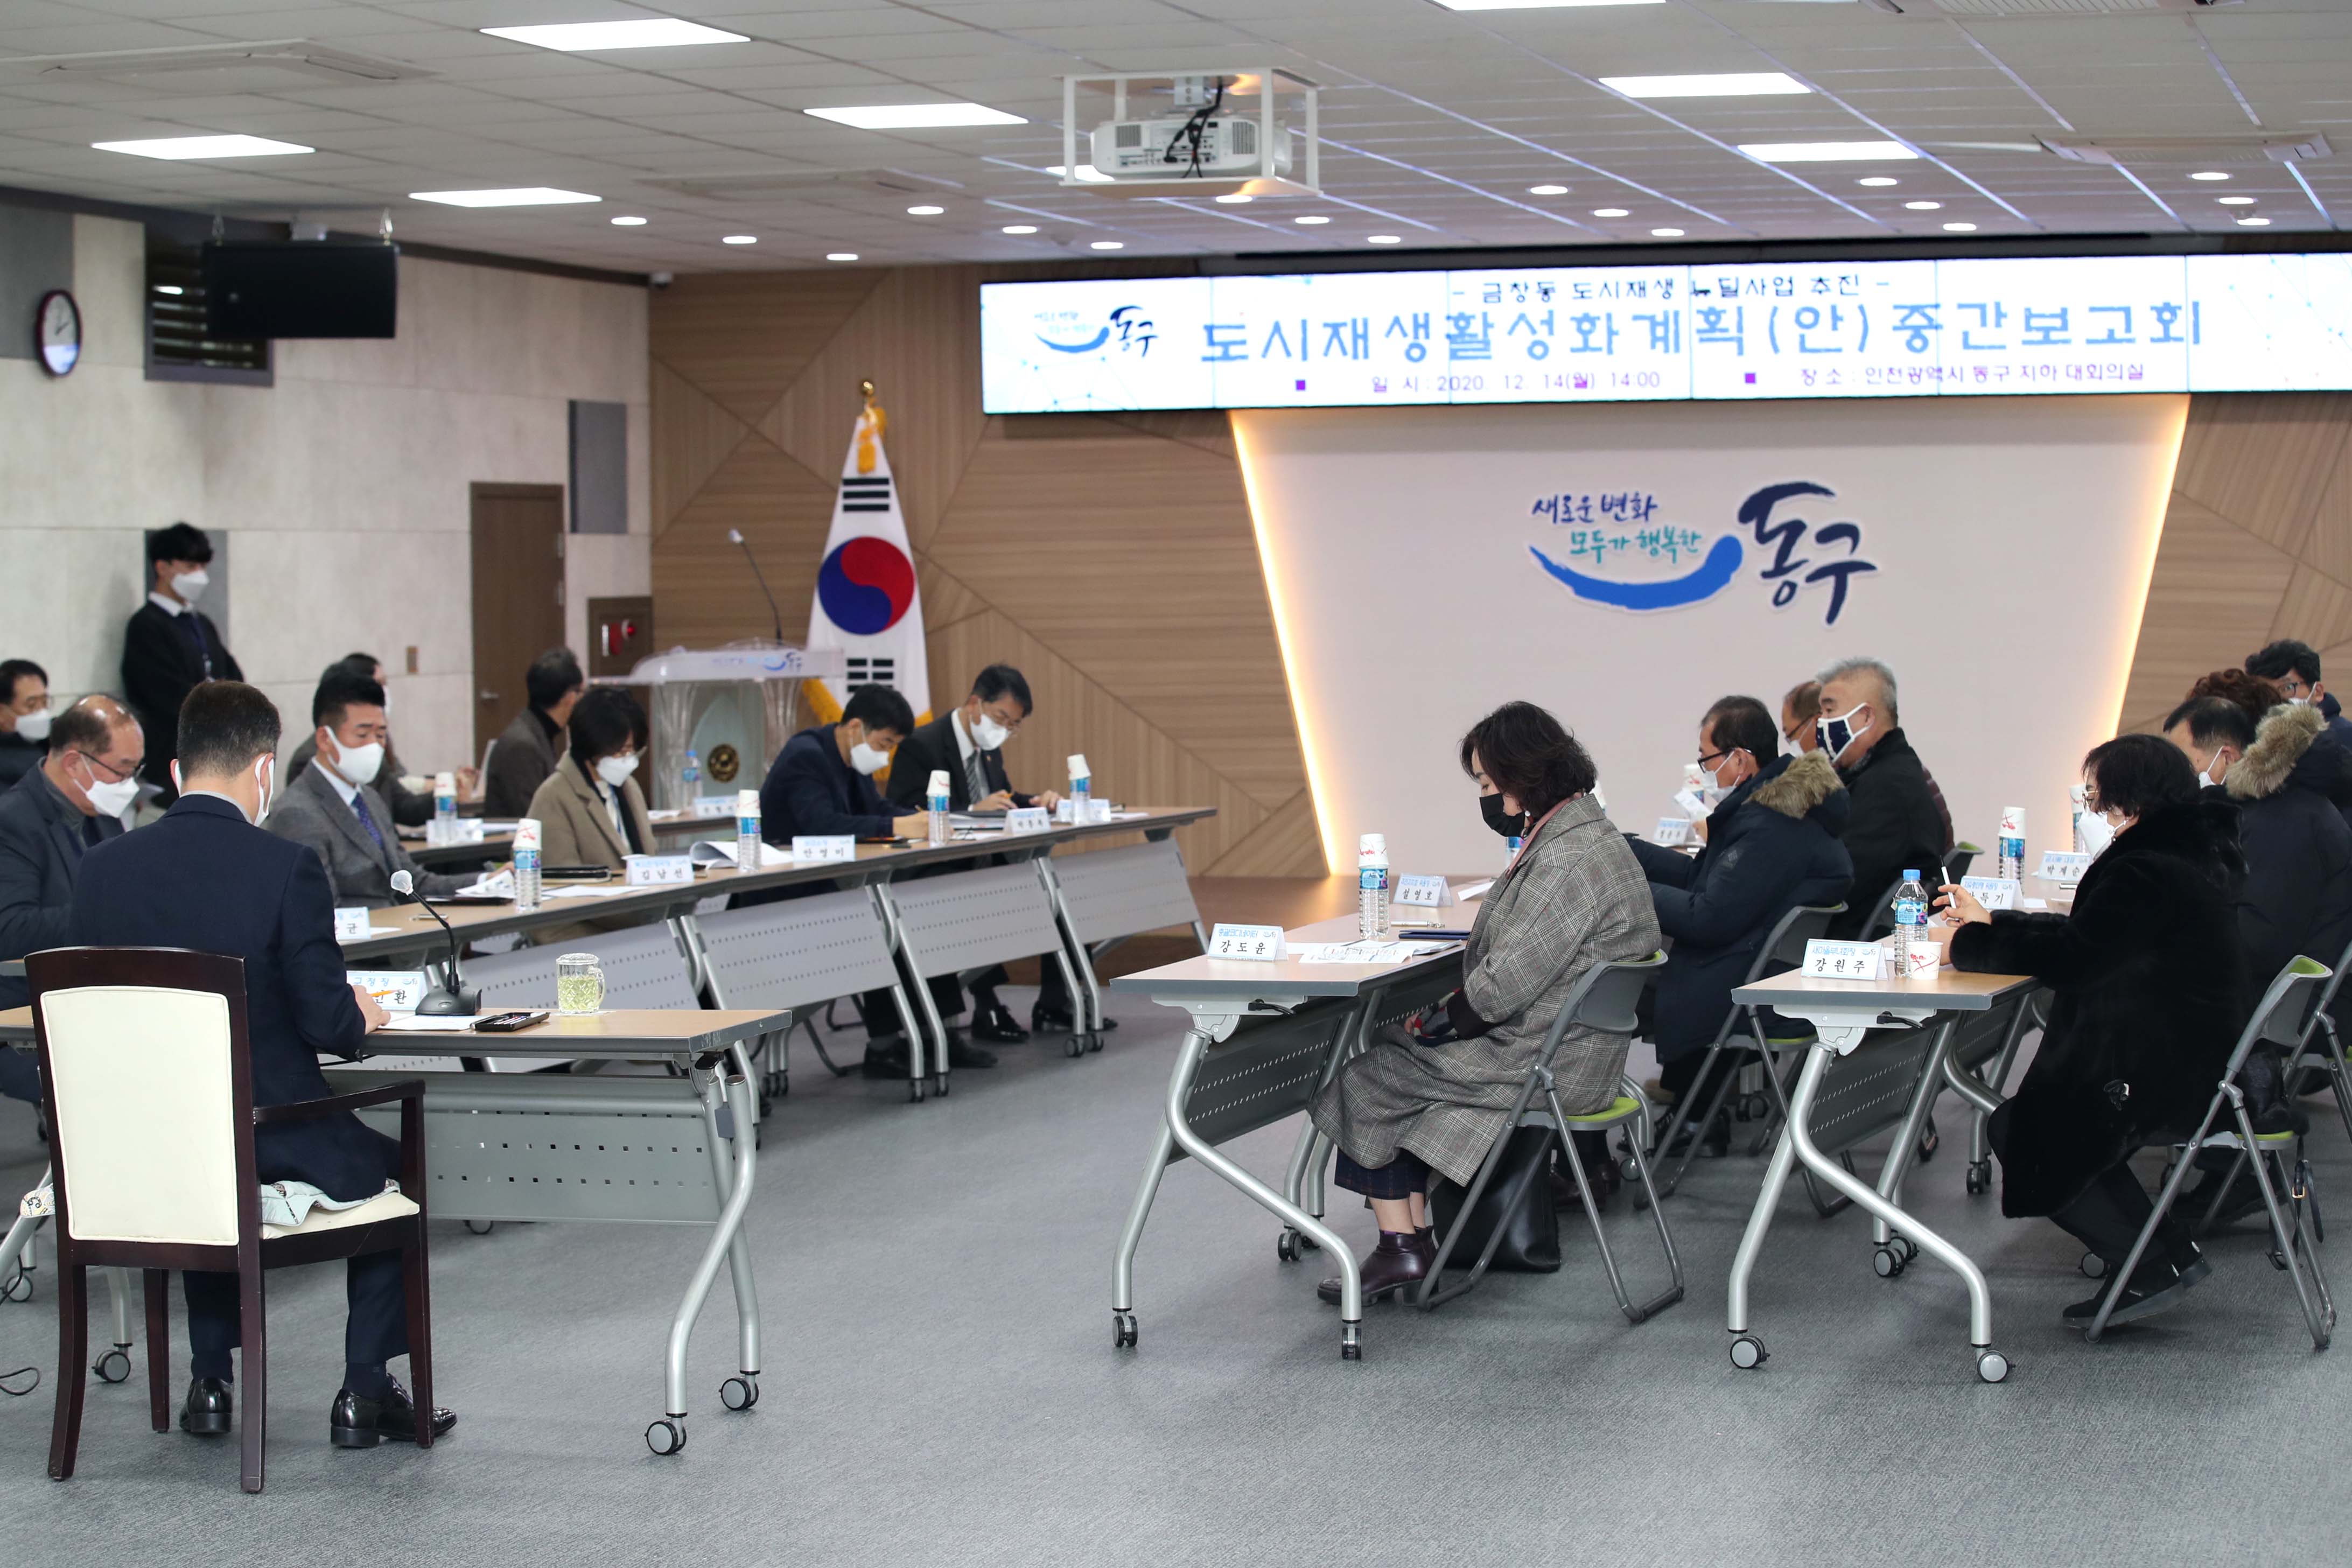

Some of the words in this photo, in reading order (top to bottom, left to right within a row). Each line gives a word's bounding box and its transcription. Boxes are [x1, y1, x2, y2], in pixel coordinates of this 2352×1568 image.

[1482, 281, 1556, 304] 금창동
[1572, 278, 1674, 300] 도시재생
[1810, 274, 1859, 295] 추진
[1110, 305, 1158, 357] 동구
[1612, 370, 1660, 388] 14:00
[1531, 494, 1595, 524] 새로운
[1600, 490, 1658, 522] 변화
[1570, 529, 1631, 564] 모두가
[1635, 525, 1702, 564] 행복한
[1737, 481, 1878, 626] 동구
